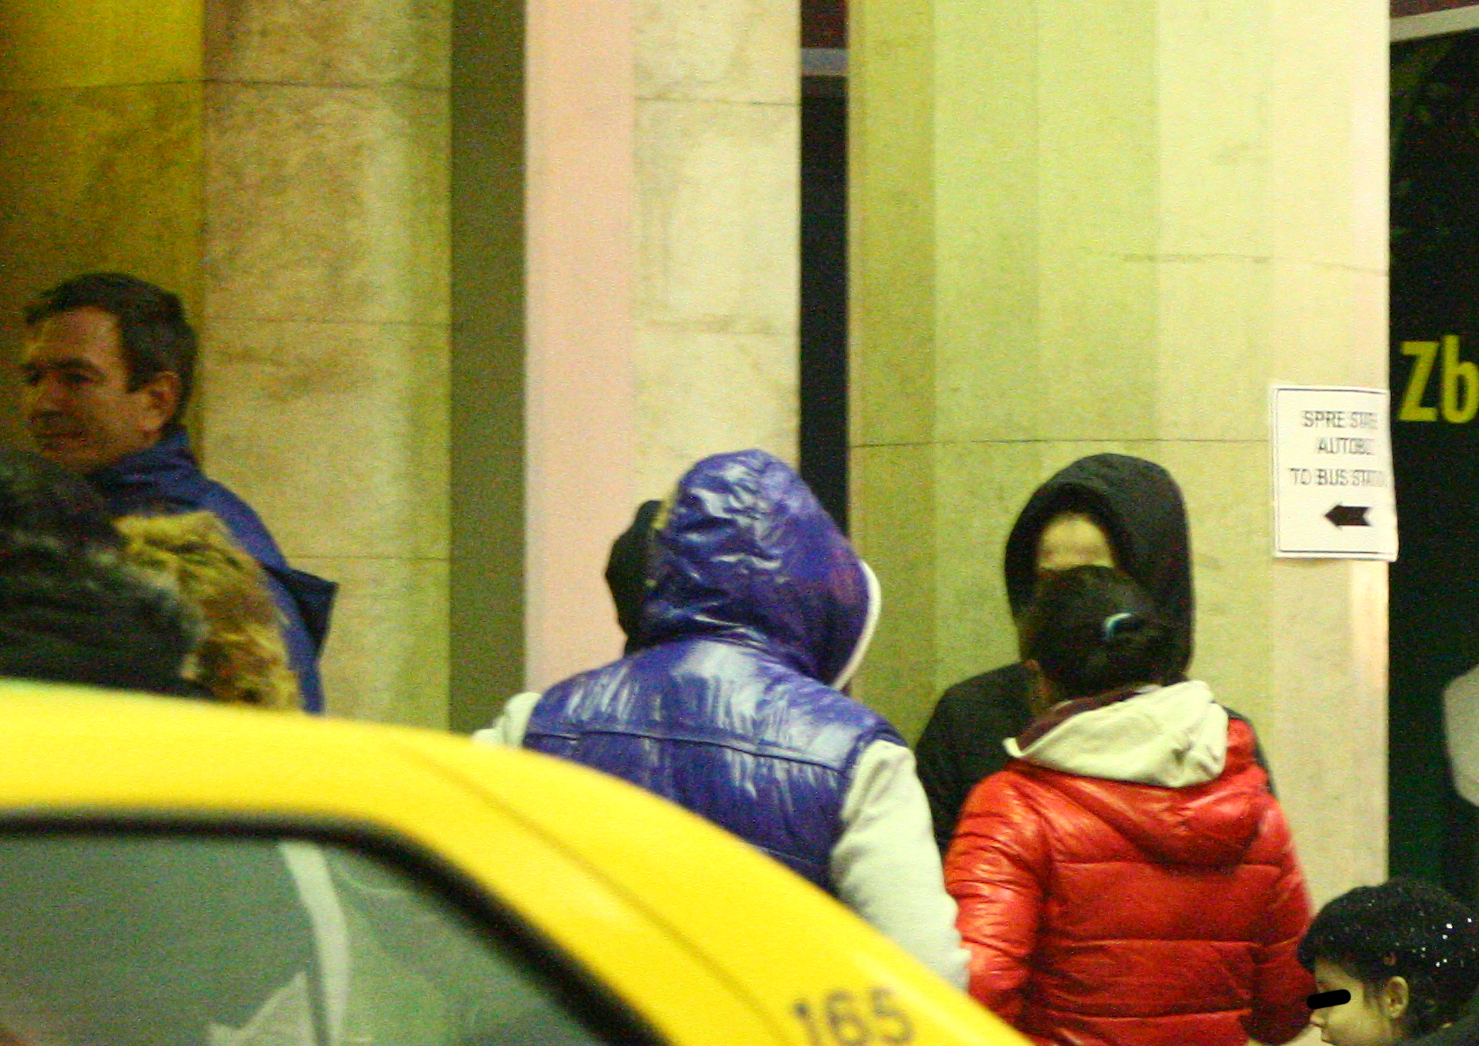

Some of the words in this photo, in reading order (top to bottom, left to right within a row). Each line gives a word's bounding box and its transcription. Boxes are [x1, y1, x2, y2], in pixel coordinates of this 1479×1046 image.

[1302, 409, 1346, 429] SPRE
[1289, 467, 1312, 486] TO
[1317, 468, 1349, 487] BUS
